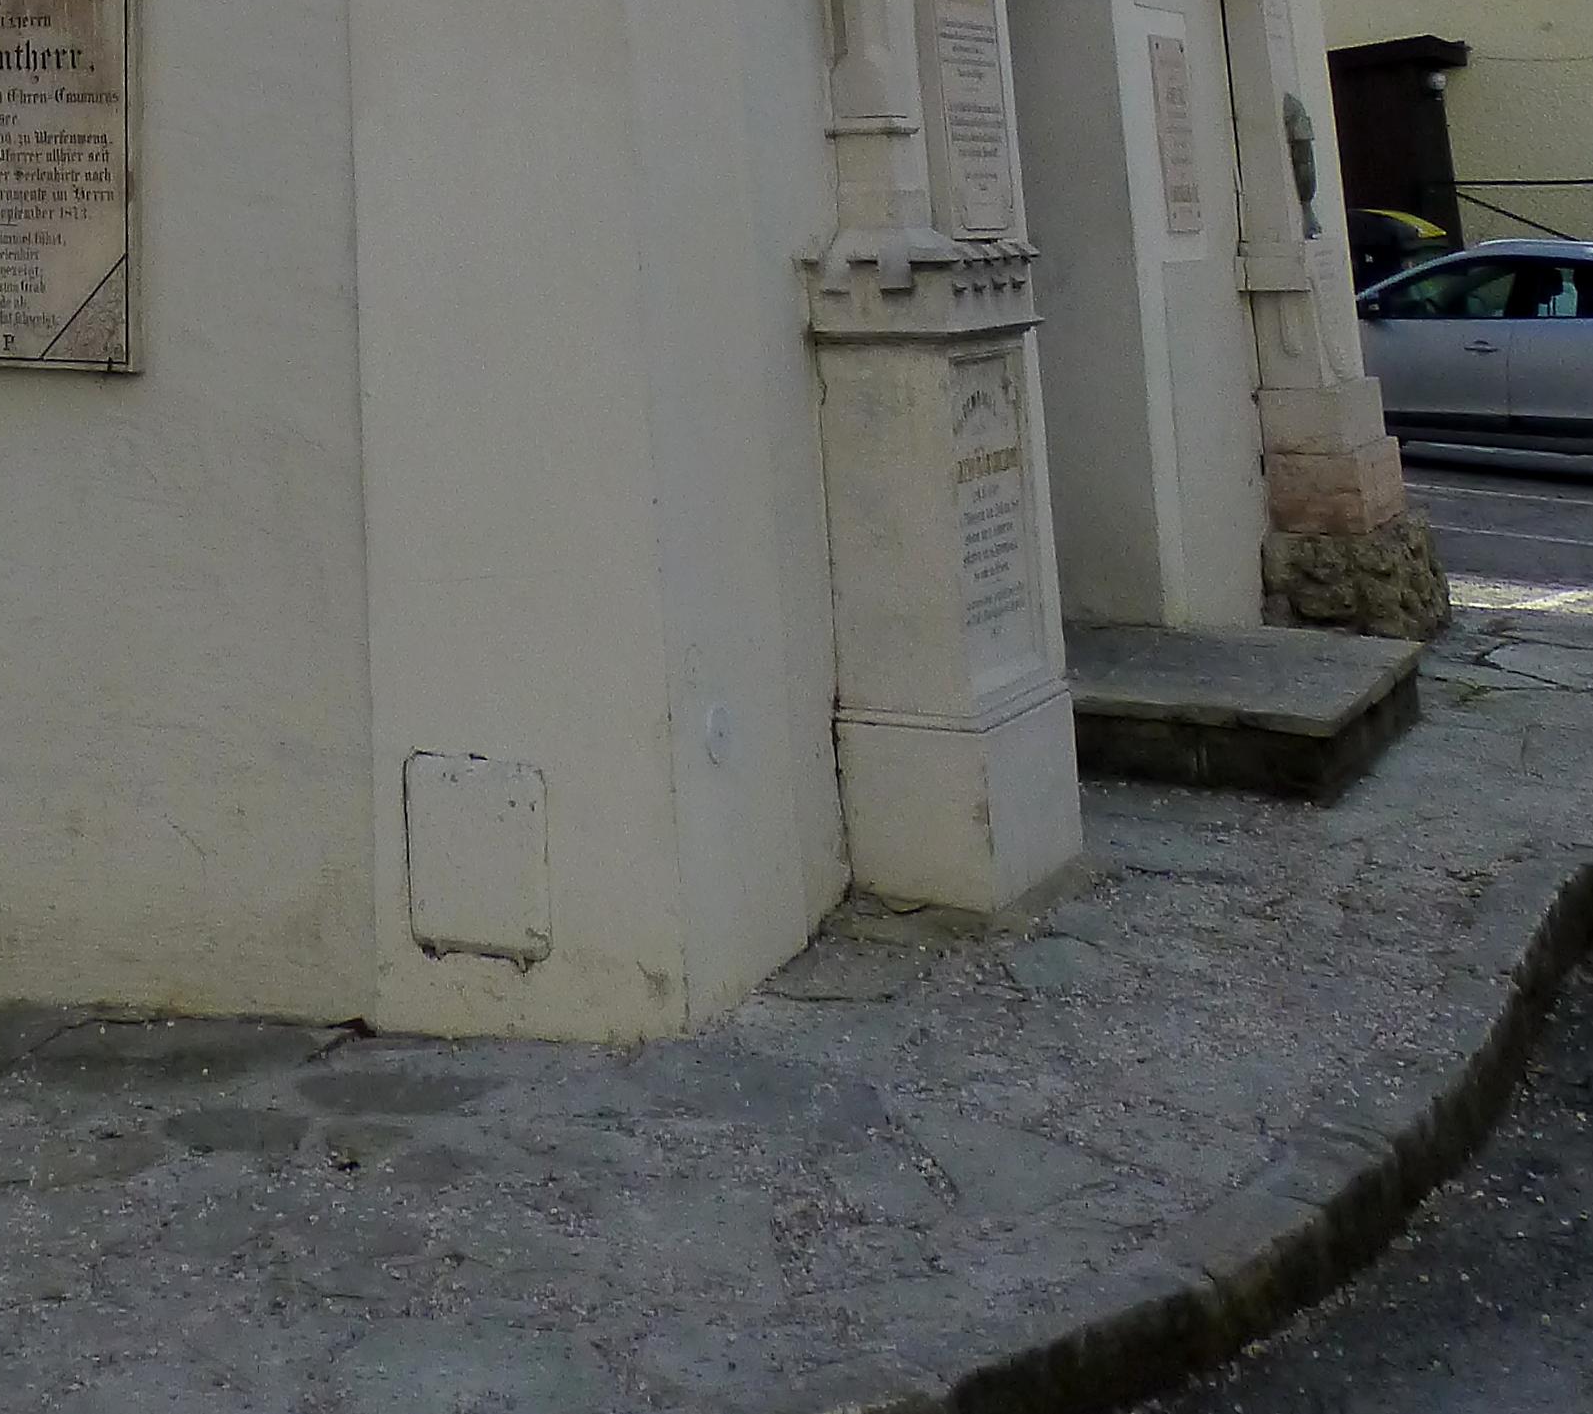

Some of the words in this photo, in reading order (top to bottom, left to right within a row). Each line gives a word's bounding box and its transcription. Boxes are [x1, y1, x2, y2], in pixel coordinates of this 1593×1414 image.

[88, 147, 111, 164] seit
[85, 166, 112, 184] nach
[72, 183, 115, 202] Herrn
